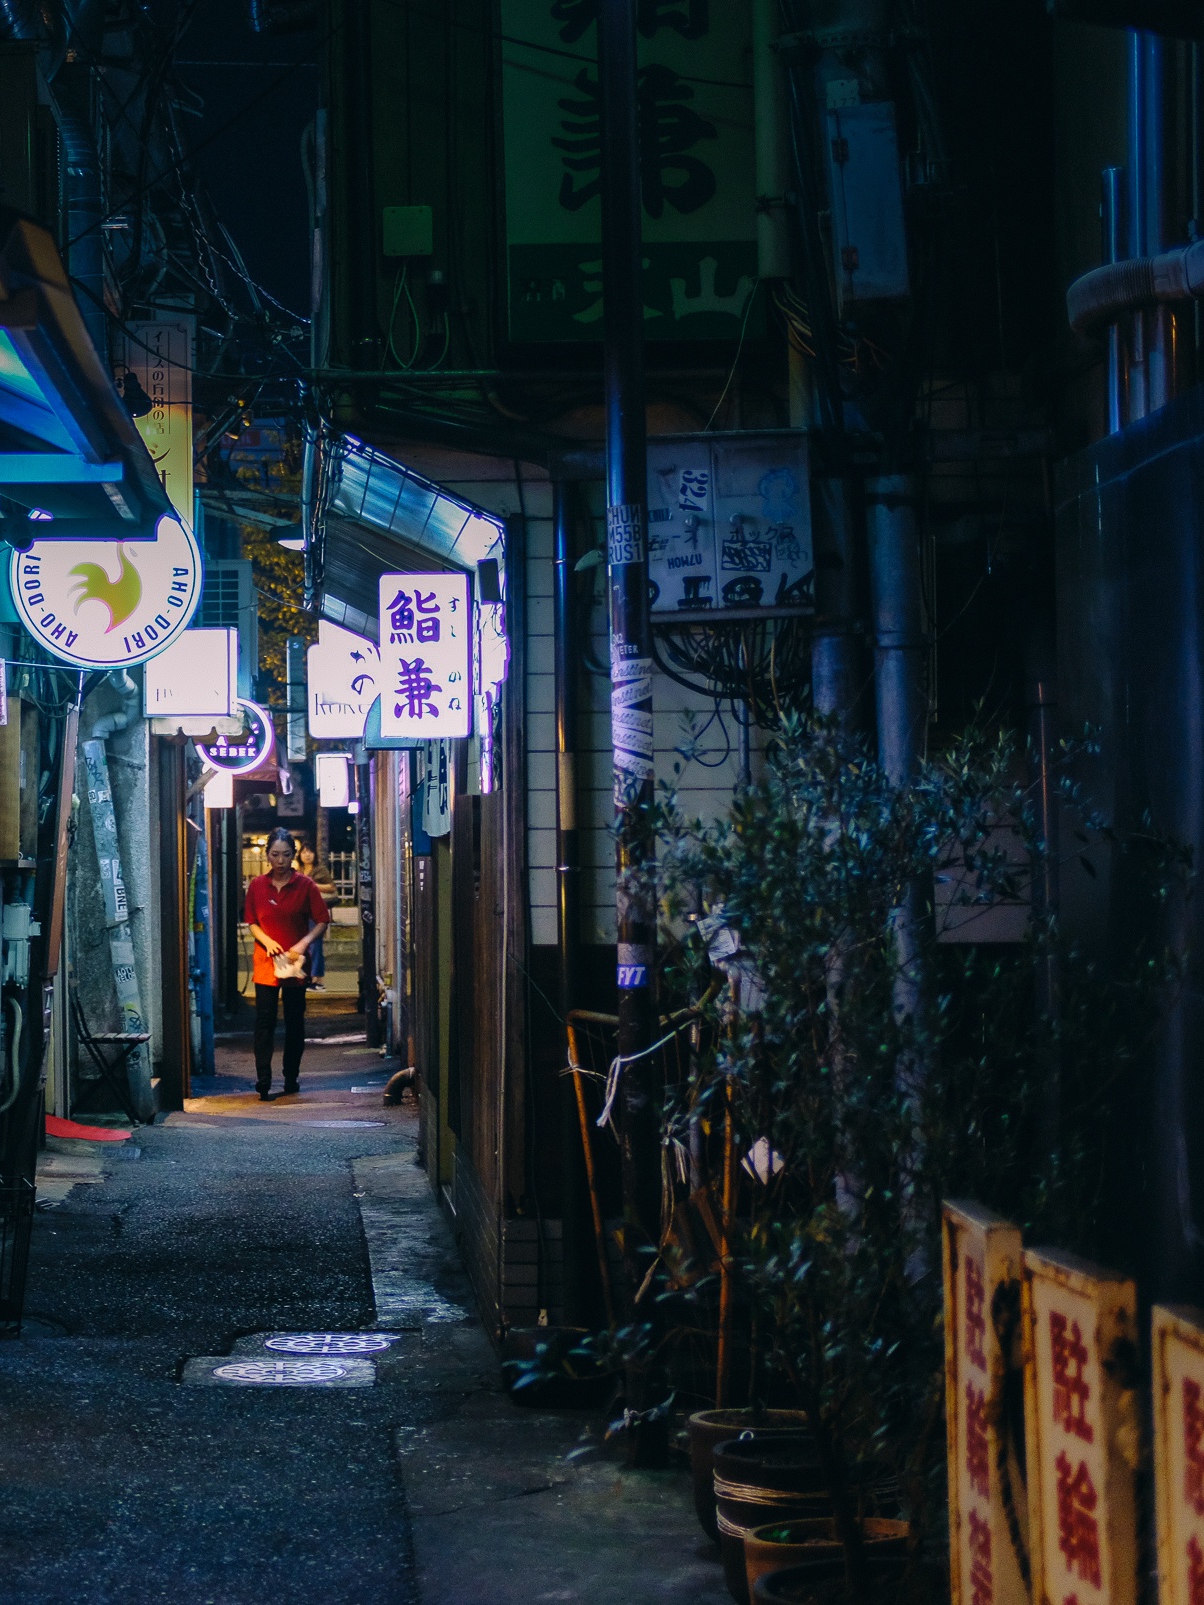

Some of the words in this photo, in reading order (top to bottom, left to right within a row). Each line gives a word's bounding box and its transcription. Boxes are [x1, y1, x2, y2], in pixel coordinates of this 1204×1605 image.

[678, 470, 708, 511] 324
[123, 566, 189, 653] AHO-DORI
[385, 589, 443, 720] 鮨兼
[1049, 1310, 1102, 1605] 駐輪
